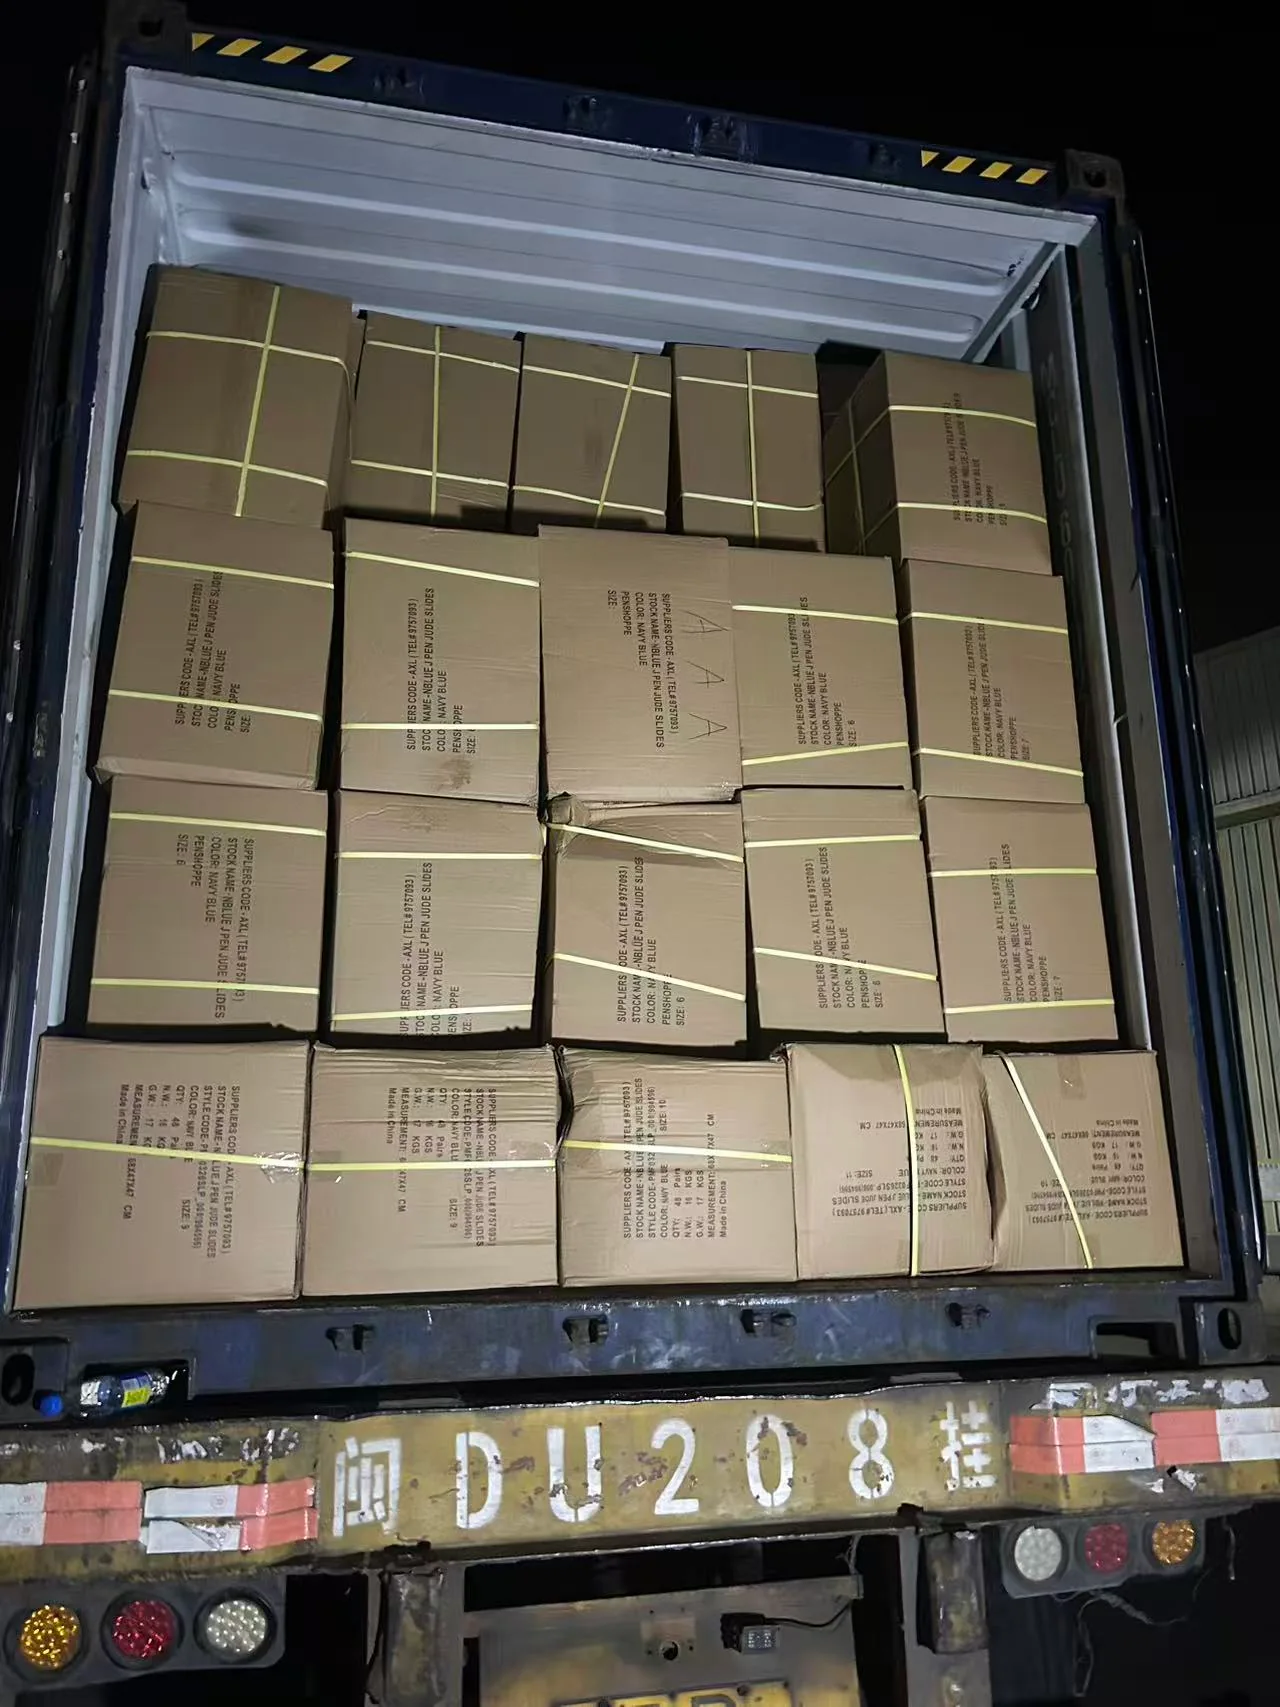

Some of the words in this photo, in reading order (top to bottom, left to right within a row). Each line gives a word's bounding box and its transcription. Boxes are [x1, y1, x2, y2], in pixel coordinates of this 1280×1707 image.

[425, 588, 434, 616] SLIDES
[621, 591, 631, 635] PENSHOPPE
[649, 593, 658, 617] STOCK
[662, 593, 673, 633] SUPPLIERS
[425, 620, 433, 640] JUDE
[637, 623, 646, 643] NAVY
[802, 630, 811, 648] JUDE
[214, 650, 226, 672] BLUE
[424, 643, 433, 659] PEN
[638, 645, 647, 666] BLUE
[804, 650, 813, 664] PEN
[212, 673, 223, 695] NAVY
[438, 671, 446, 693] BLUE
[653, 676, 661, 690] PEN
[818, 673, 828, 693] BLUE
[438, 696, 446, 718] NAVY
[653, 692, 662, 712] JUDE
[820, 695, 829, 715] NAVY
[654, 715, 664, 748] SLIDES
[796, 705, 807, 744] SUPPLIERS
[809, 721, 819, 744] STOCK
[834, 702, 844, 745] PENSHOPPE
[191, 835, 204, 886] PENSHOPPE
[226, 838, 238, 866] STOCK
[241, 839, 254, 885] SUPPLIERS
[819, 847, 829, 875] SLIDES
[422, 863, 432, 892] SLIDES
[635, 857, 644, 883] SLIDES
[207, 872, 218, 895] NAVY
[821, 877, 831, 898] JUDE
[1004, 878, 1014, 898] JUDE
[421, 896, 430, 919] JUDE
[635, 887, 643, 908] JUDE
[824, 900, 833, 916] PEN
[1006, 900, 1016, 915] PEN
[205, 898, 217, 922] BLUE
[634, 911, 643, 927] PEN
[420, 922, 429, 939] PEN
[839, 928, 849, 950] BLUE
[1023, 924, 1032, 946] BLUE
[220, 934, 231, 951] PEN
[648, 940, 656, 962] BLUE
[218, 953, 229, 976] JUDE
[434, 951, 443, 975] BLUE
[1025, 948, 1034, 969] NAVY
[433, 978, 442, 1002] NAVY
[815, 964, 828, 1008] SUPPLIERS
[999, 959, 1012, 1001] SUPPLIERS
[1014, 975, 1024, 1002] STOCK
[618, 975, 627, 1022] SUPPLIERS
[831, 981, 841, 1008] STOCK
[633, 994, 642, 1022] STOCK
[119, 1084, 129, 1107] Made
[202, 1086, 212, 1112] STYLE
[215, 1086, 226, 1115] STOCK
[387, 1088, 396, 1109] Made
[476, 1088, 484, 1115] STOCK
[634, 1078, 643, 1104] SLIDES
[229, 1086, 240, 1133] SUPPLIERS
[488, 1089, 496, 1132] SUPPLIERS
[635, 1106, 643, 1124] JUDE
[707, 1114, 715, 1126] CM
[386, 1121, 395, 1144] China
[412, 1136, 420, 1154] KGS
[425, 1136, 433, 1153] KGS
[660, 1164, 668, 1183] BLUE
[696, 1170, 704, 1187] KGS
[945, 1179, 965, 1187] STYLE
[719, 1181, 727, 1204] China
[832, 1196, 859, 1205] SLIDES
[944, 1190, 966, 1199] STOCK
[398, 1199, 406, 1212] CM
[929, 1202, 967, 1211] SUPPLIERS
[476, 1215, 484, 1247] SLIDES
[636, 1209, 644, 1238] STOCK
[719, 1216, 727, 1237] Made
